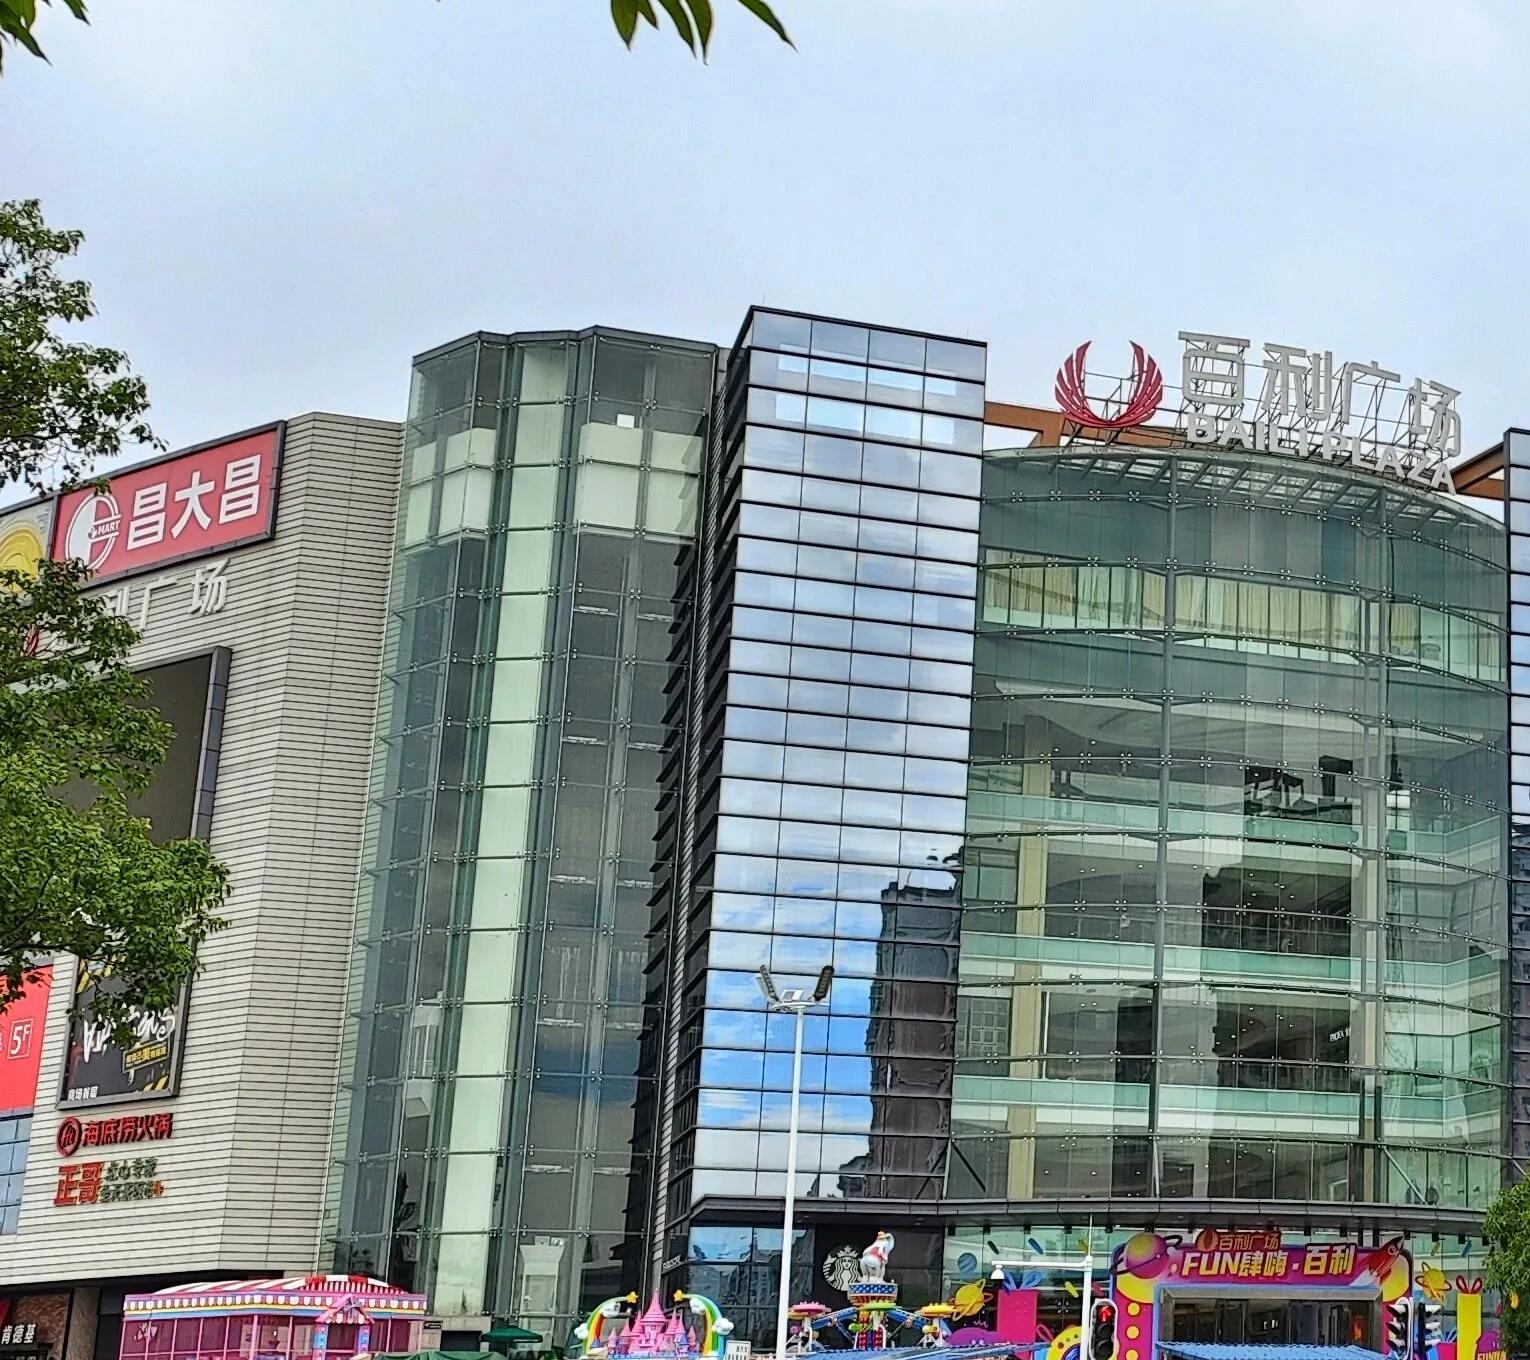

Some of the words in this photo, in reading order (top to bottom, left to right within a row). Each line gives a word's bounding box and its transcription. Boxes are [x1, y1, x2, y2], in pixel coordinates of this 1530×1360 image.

[1179, 330, 1462, 458] 百利广场
[1186, 412, 1309, 458] BAILI
[1322, 430, 1456, 495] PLAZA
[127, 454, 261, 551] 昌大昌
[10, 1024, 31, 1055] 5F
[82, 1113, 173, 1147] 海底捞火锅
[54, 1161, 104, 1207] 正哥
[1219, 1232, 1281, 1251] 百利广场
[1, 1323, 36, 1344] 肯德基
